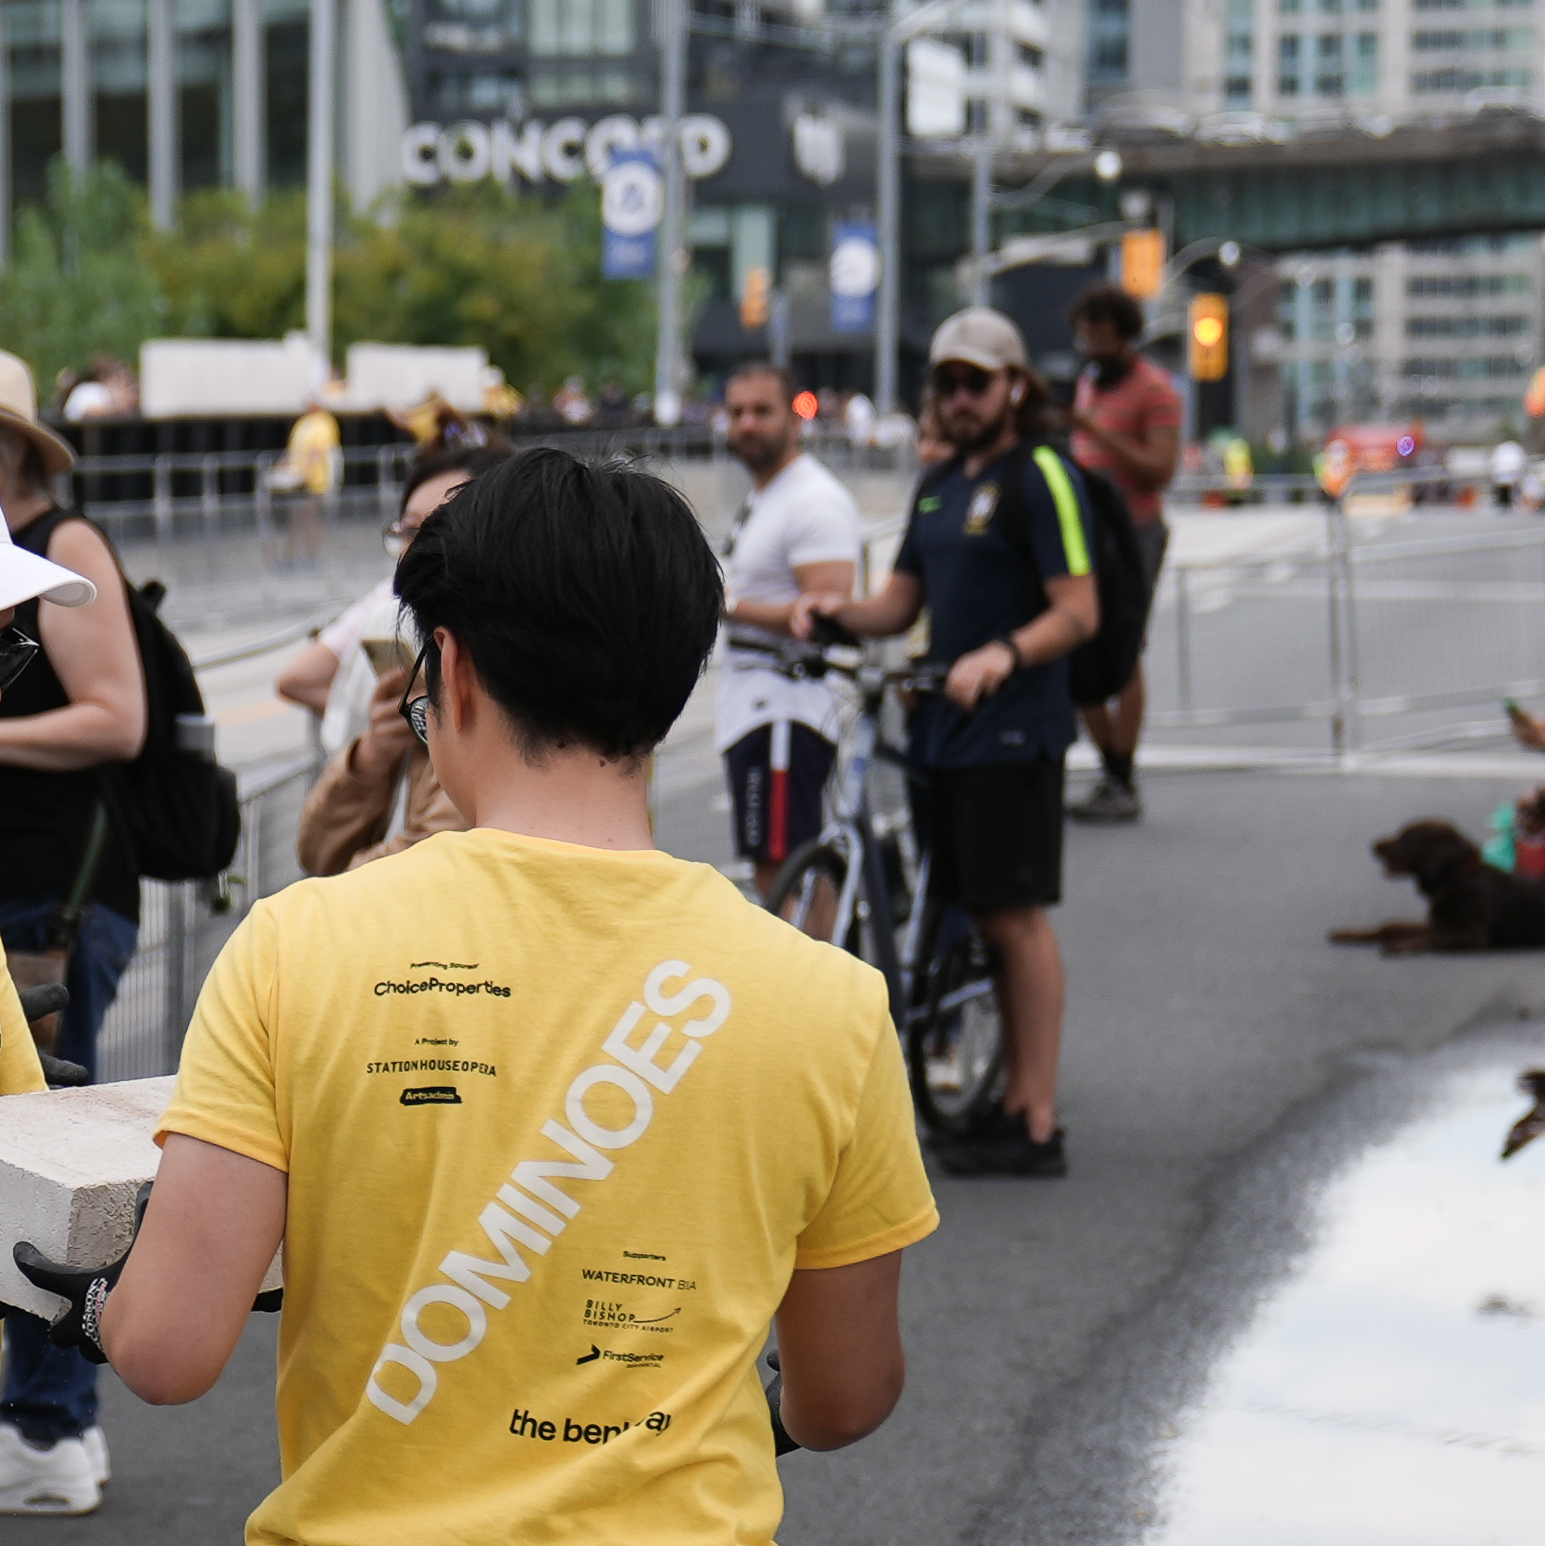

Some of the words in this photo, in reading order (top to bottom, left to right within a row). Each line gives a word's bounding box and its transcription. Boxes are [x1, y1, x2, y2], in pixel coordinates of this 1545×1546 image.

[373, 977, 511, 998] ChoiceProperties
[421, 1037, 447, 1046] Project
[449, 1038, 459, 1047] by
[366, 959, 731, 1425] DOMINOES
[623, 1250, 666, 1261] Supporters
[582, 1269, 675, 1289] WATERFRONT
[677, 1279, 697, 1290] BIA
[586, 1299, 623, 1312] BILLY
[584, 1309, 635, 1323] BISHOP
[583, 1319, 620, 1329] TORONTO
[603, 1350, 664, 1362] FirstService
[509, 1408, 557, 1441] the
